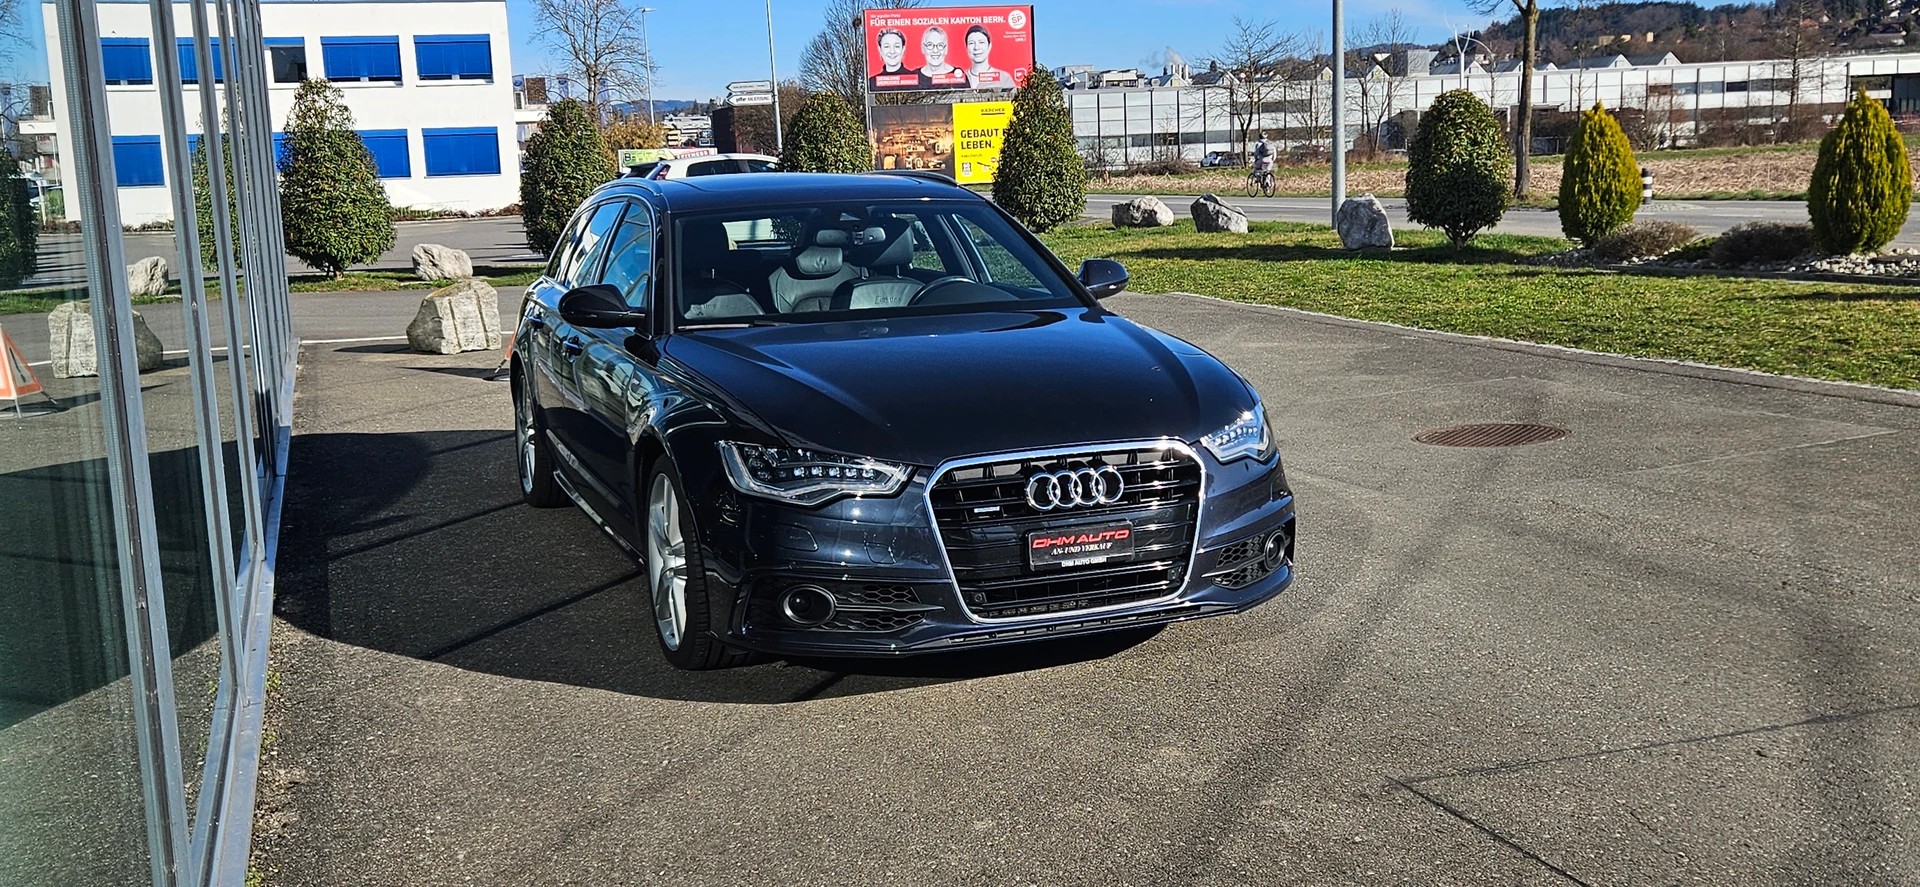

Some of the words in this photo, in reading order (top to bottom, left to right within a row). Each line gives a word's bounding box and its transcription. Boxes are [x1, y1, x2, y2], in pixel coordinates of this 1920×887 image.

[870, 18, 886, 27] FÜR
[887, 18, 911, 26] EINEN
[912, 17, 949, 25] SOZIALEN
[950, 16, 982, 25] KANTON
[983, 15, 1005, 23] BERN.
[1011, 15, 1023, 23] SP
[960, 128, 999, 138] GEBAUT
[961, 140, 995, 150] LEBEN.
[1076, 529, 1130, 543] AUTO
[1081, 542, 1113, 552] VERKAUF
